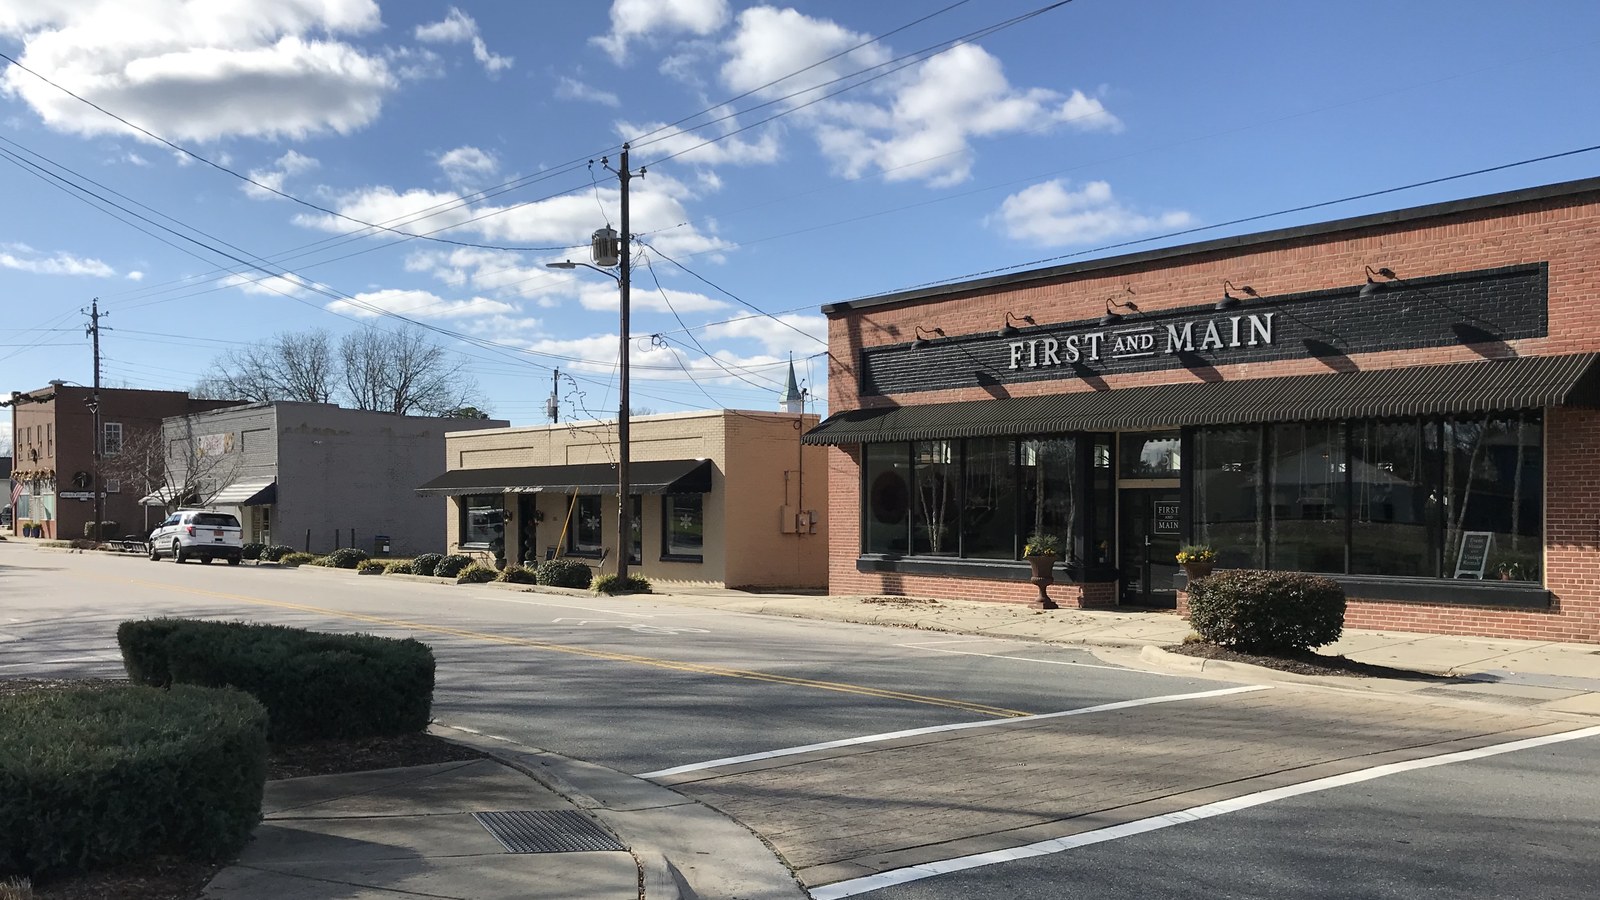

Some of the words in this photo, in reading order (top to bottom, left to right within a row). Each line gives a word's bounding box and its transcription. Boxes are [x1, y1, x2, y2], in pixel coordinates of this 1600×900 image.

[1008, 331, 1104, 370] FIRST
[1113, 334, 1154, 352] AND
[1165, 312, 1274, 354] MAIN
[1158, 506, 1179, 514] FIRST
[1158, 521, 1179, 529] MAIN
